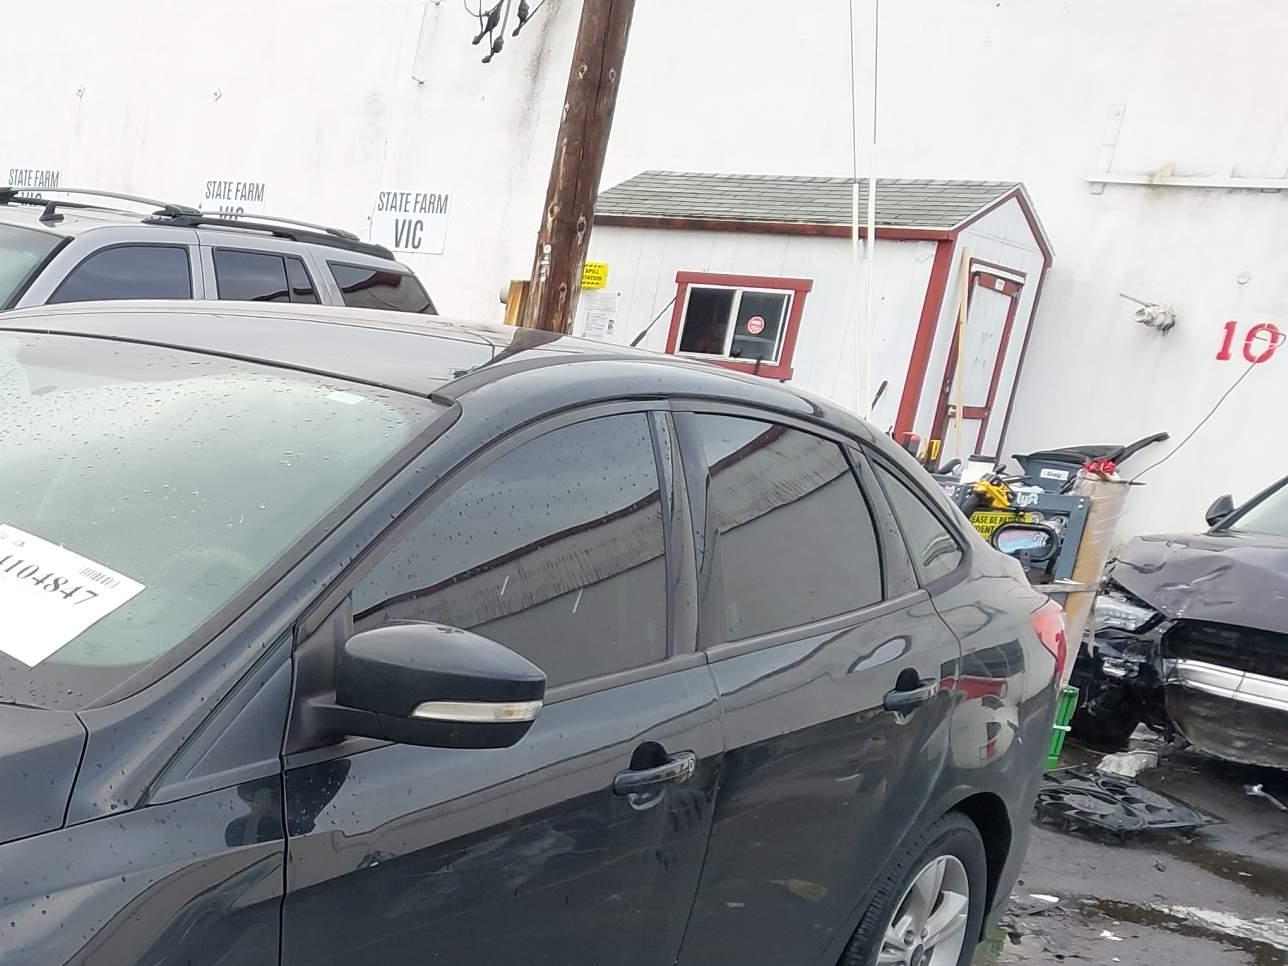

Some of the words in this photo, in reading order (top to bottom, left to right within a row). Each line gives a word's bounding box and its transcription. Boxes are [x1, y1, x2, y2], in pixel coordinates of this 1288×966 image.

[8, 168, 33, 187] STATE
[34, 170, 60, 188] FARM
[205, 180, 233, 200] STATE
[234, 182, 265, 202] FARM
[377, 191, 412, 213] STATE
[413, 193, 449, 214] FARM
[394, 218, 424, 250] VIC
[1215, 320, 1280, 364] 10
